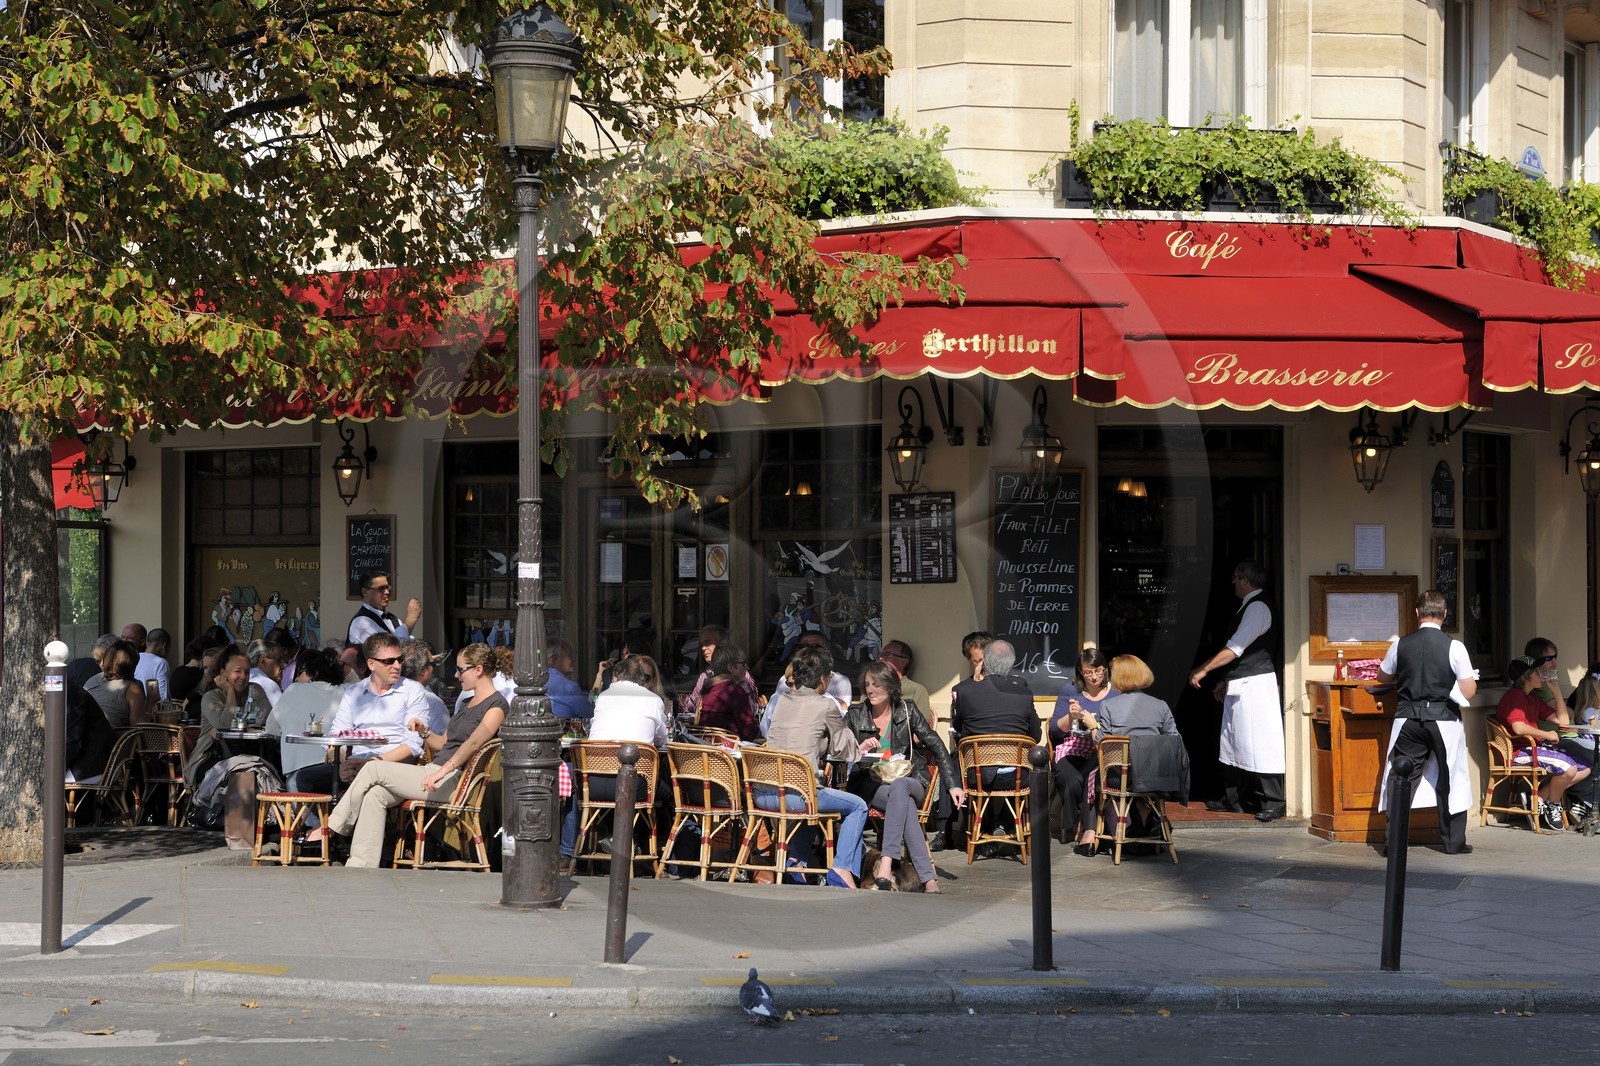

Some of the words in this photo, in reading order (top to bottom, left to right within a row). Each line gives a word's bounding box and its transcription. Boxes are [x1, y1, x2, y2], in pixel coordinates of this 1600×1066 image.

[1165, 230, 1243, 270] Café
[922, 328, 1058, 360] Berthillon
[1186, 353, 1393, 387] Brasserie
[402, 366, 515, 399] Saint
[997, 474, 1036, 500] PLAT
[351, 523, 362, 537] LA
[364, 536, 375, 544] DE
[351, 544, 391, 556] CHAMPAGNE
[355, 558, 384, 568] CHARLES
[998, 581, 1016, 593] DE
[1018, 578, 1073, 594] POMMES
[1007, 599, 1025, 611] DE
[1025, 596, 1070, 611] TERRE
[1008, 619, 1059, 635] MAISON
